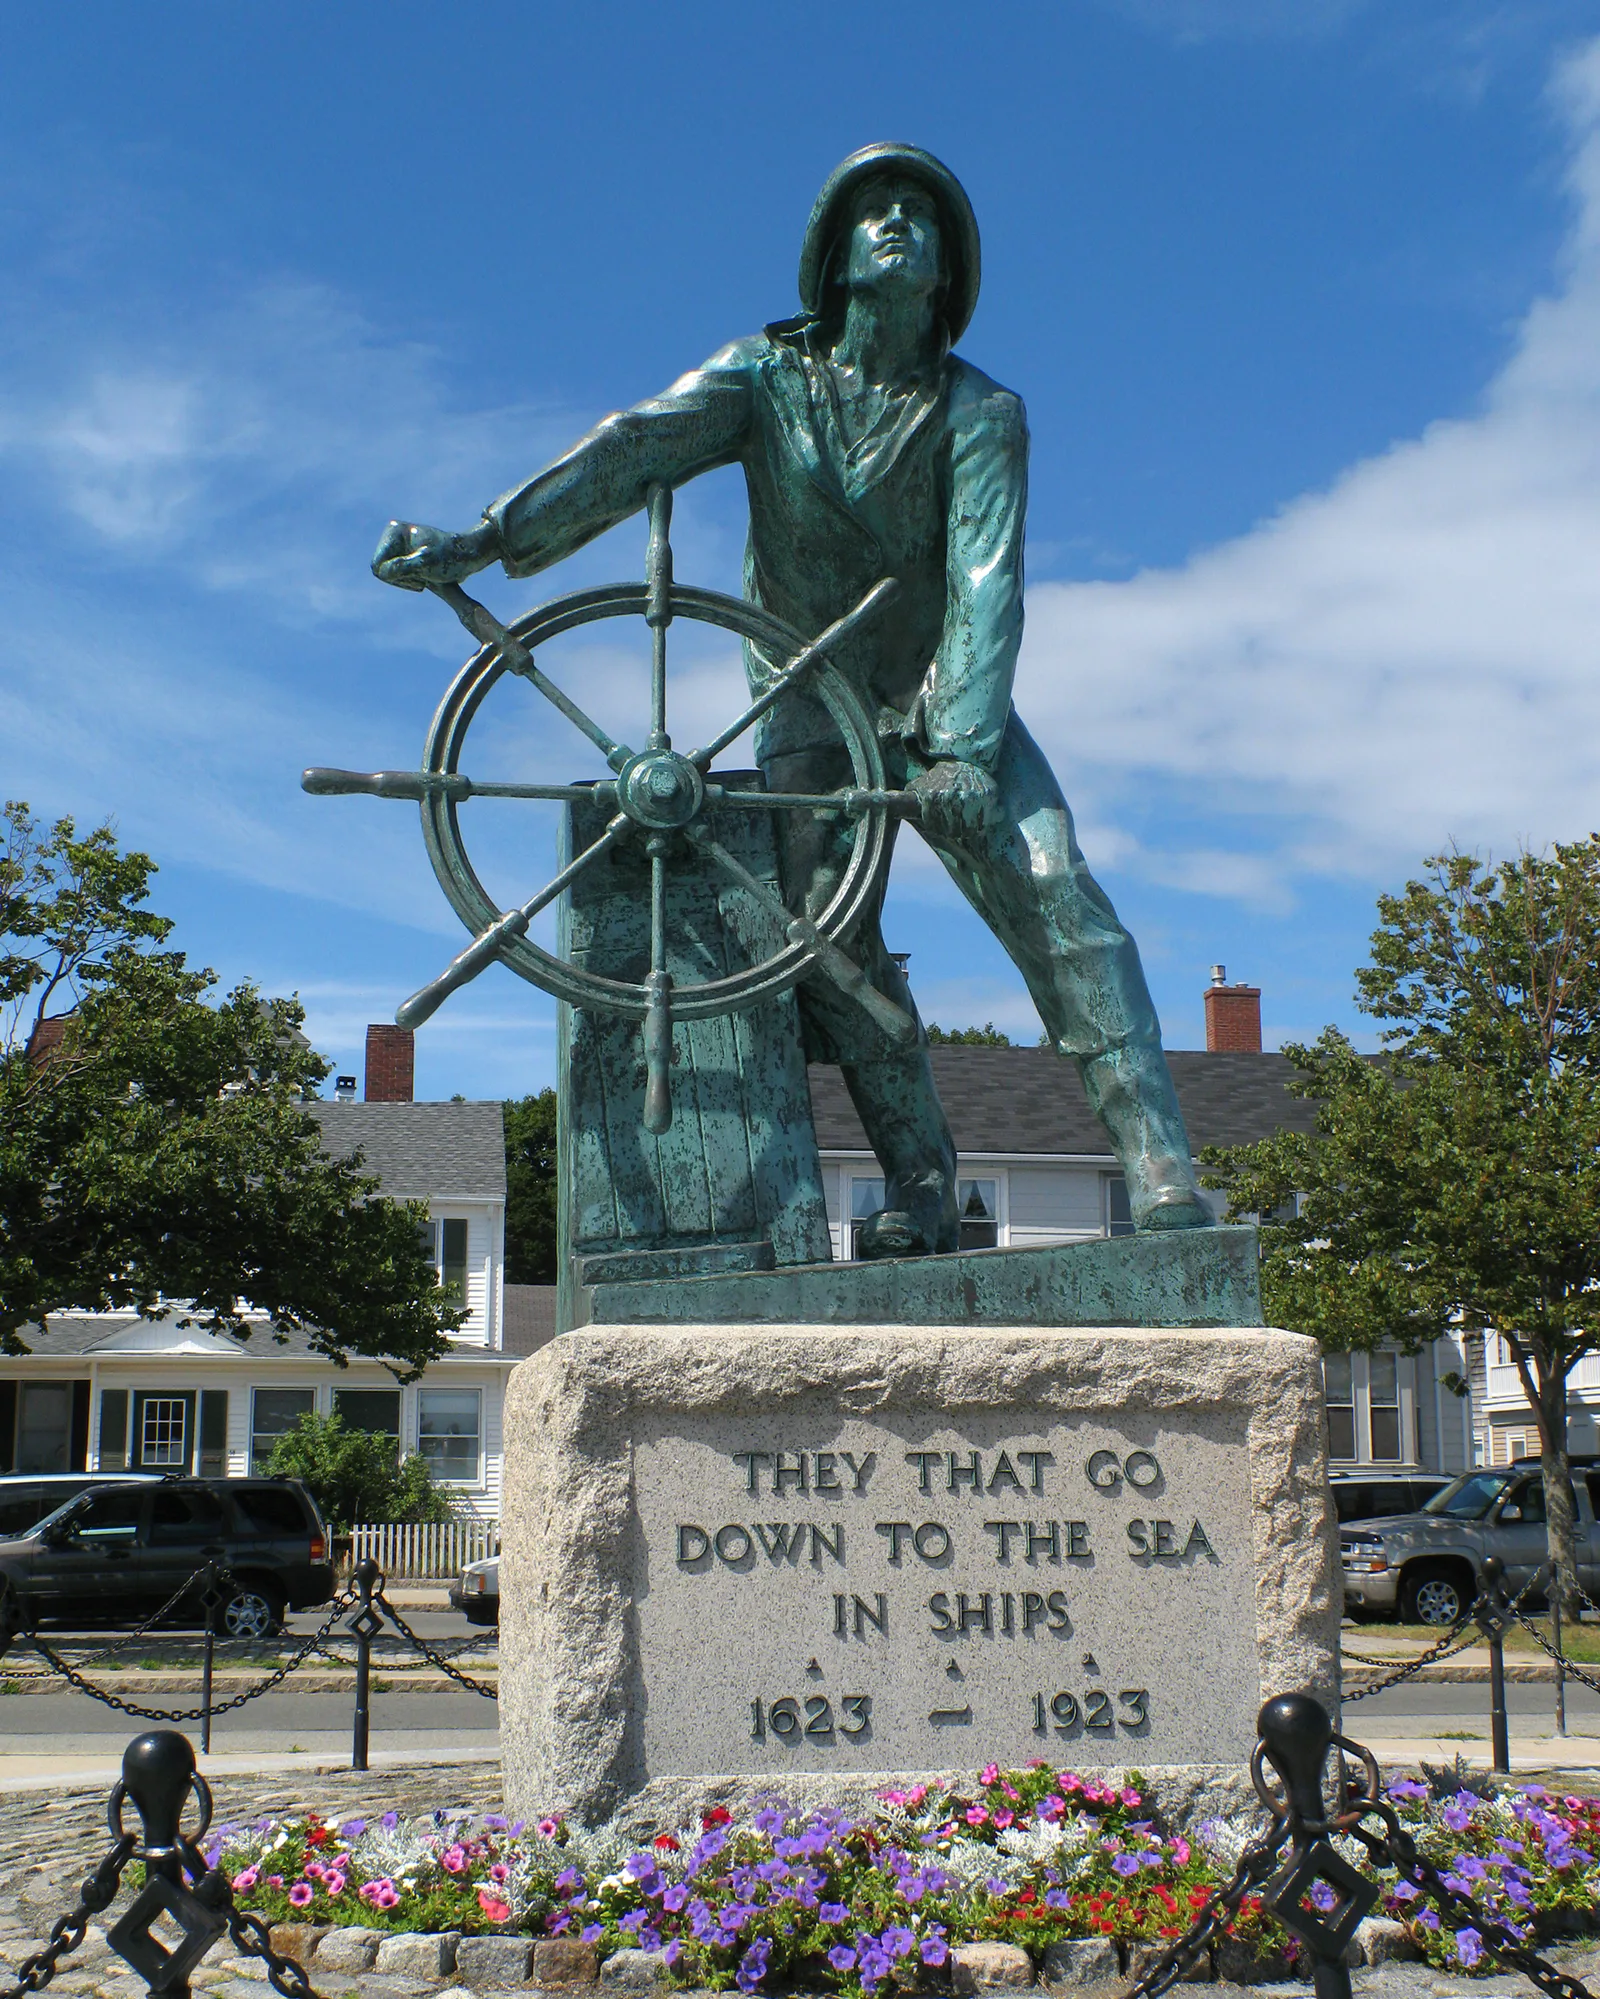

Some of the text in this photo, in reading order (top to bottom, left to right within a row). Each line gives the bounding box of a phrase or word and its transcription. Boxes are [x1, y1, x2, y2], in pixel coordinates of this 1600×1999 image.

[733, 1449, 1159, 1489] THEY THAT GO
[675, 1517, 1217, 1562] DOWN TO THE SEA
[832, 1590, 1069, 1633] IN SHIPS
[750, 1694, 869, 1736] 1623
[1032, 1688, 1147, 1730] 1923
